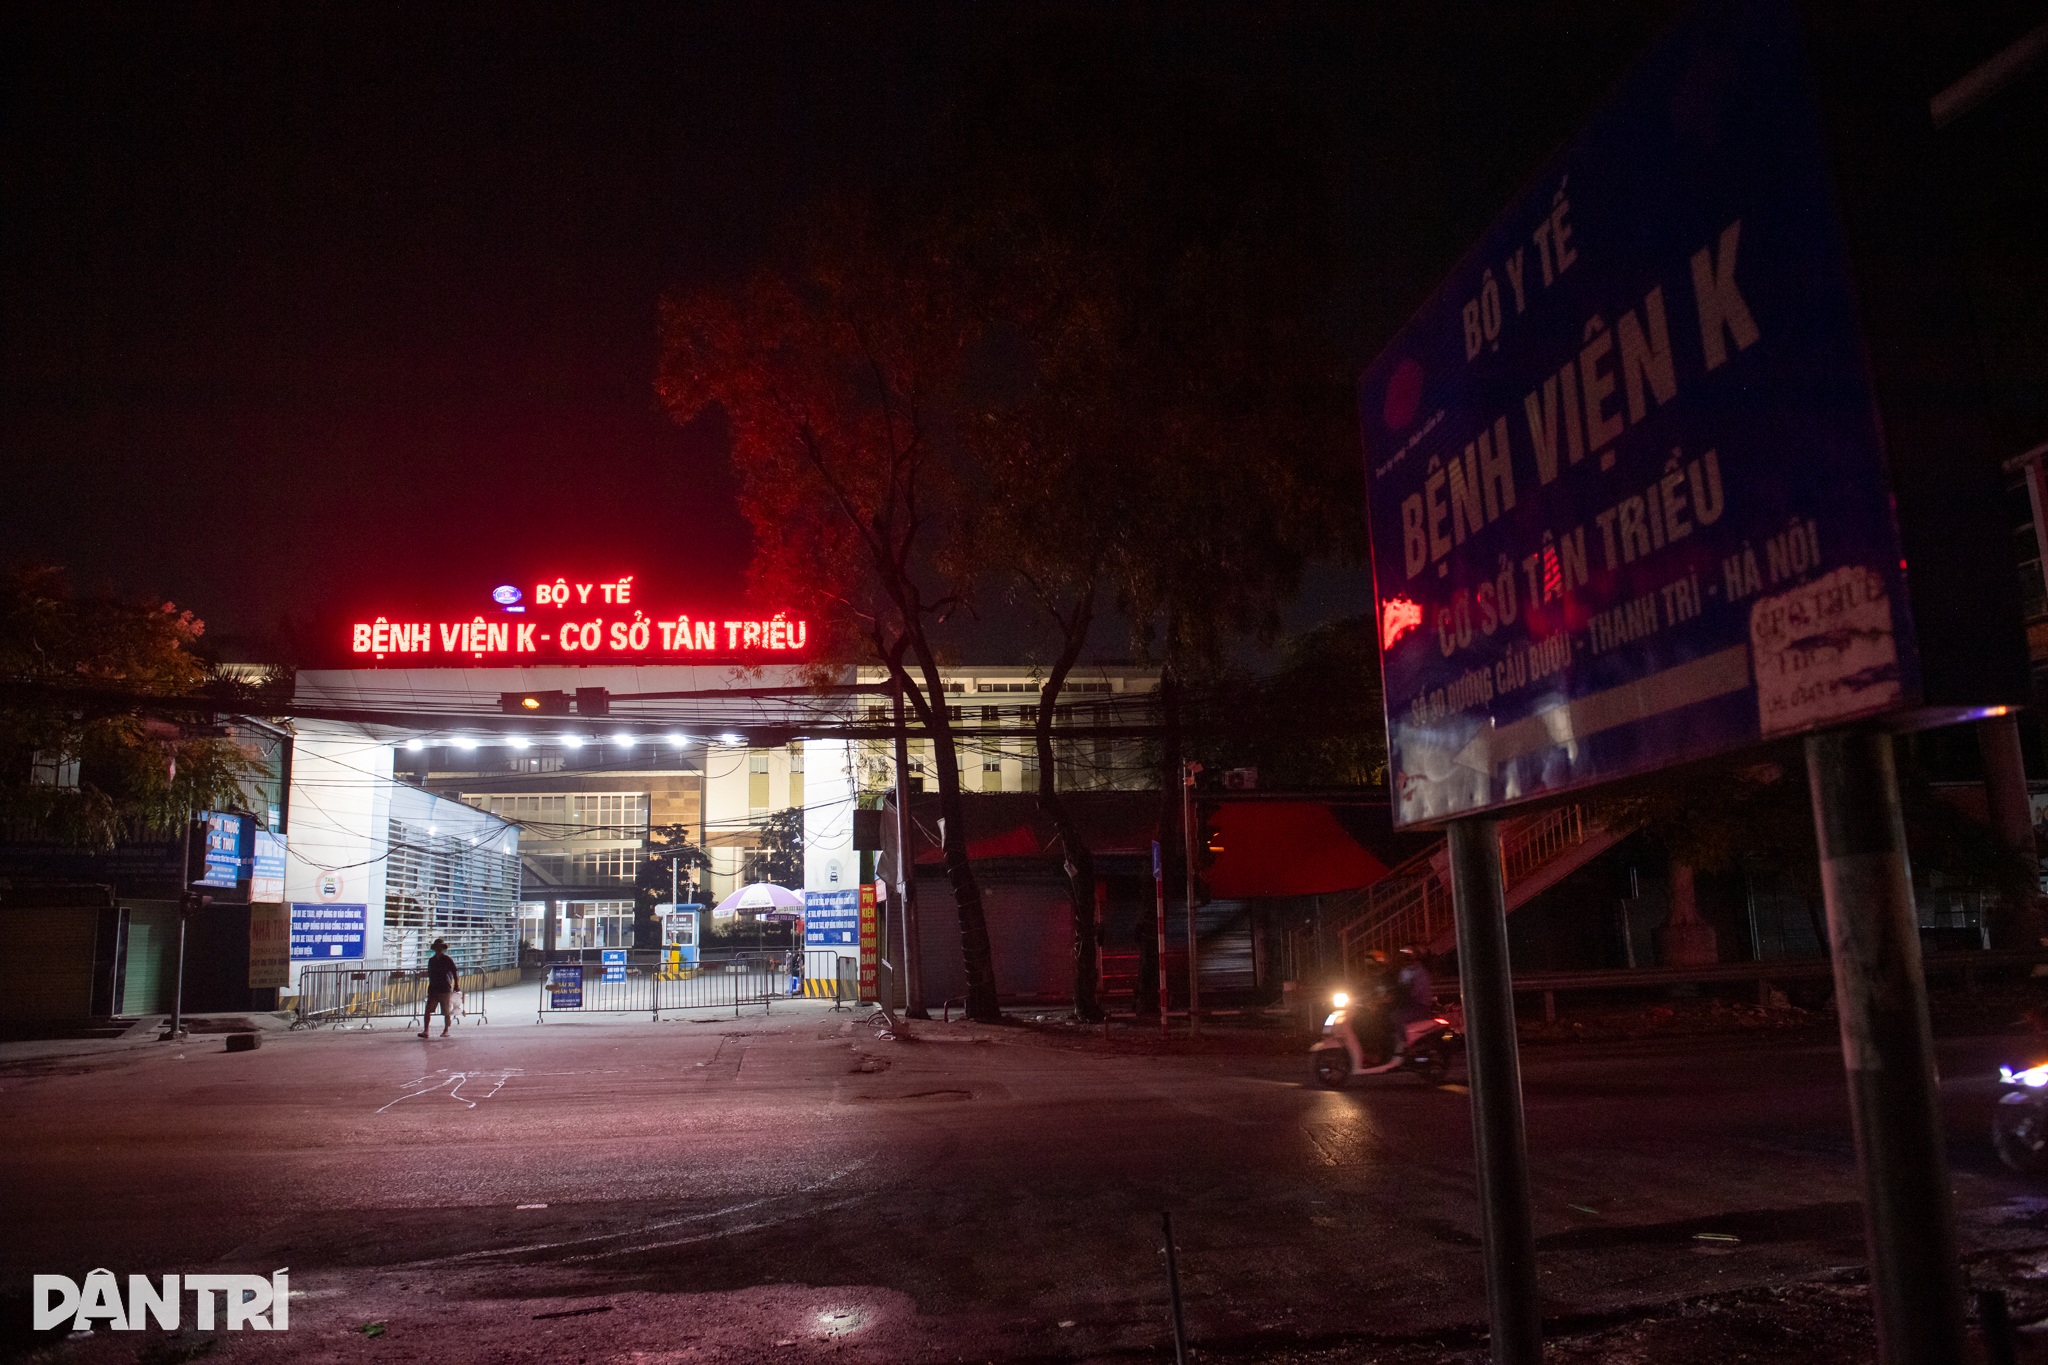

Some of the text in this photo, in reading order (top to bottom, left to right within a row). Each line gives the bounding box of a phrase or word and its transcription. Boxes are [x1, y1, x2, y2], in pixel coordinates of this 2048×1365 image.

[1463, 174, 1578, 362] BỘ Y TẾ
[1401, 415, 1516, 580] BỆNH
[1524, 283, 1677, 486] VIỆN
[1690, 218, 1760, 373] K
[536, 576, 633, 608] BỘ Y TẾ
[1438, 588, 1472, 657] CƠ
[1477, 553, 1517, 636] SỞ
[1522, 529, 1588, 611] TÂN
[1588, 592, 1658, 655] THANH
[1722, 540, 1763, 602] HÀ
[1767, 516, 1821, 585] NỘI
[353, 616, 430, 659] BỆNH
[439, 616, 508, 659] VIỆN
[516, 623, 536, 652] K
[559, 618, 602, 651] CƠ
[610, 610, 651, 650] SỞ
[658, 615, 715, 651] TÂN
[861, 906, 875, 920] KIỆN
[862, 893, 873, 905] PHỤ
[861, 921, 875, 935] ĐIỆN
[861, 937, 876, 950] THOẠI
[862, 970, 876, 984] TẠP
